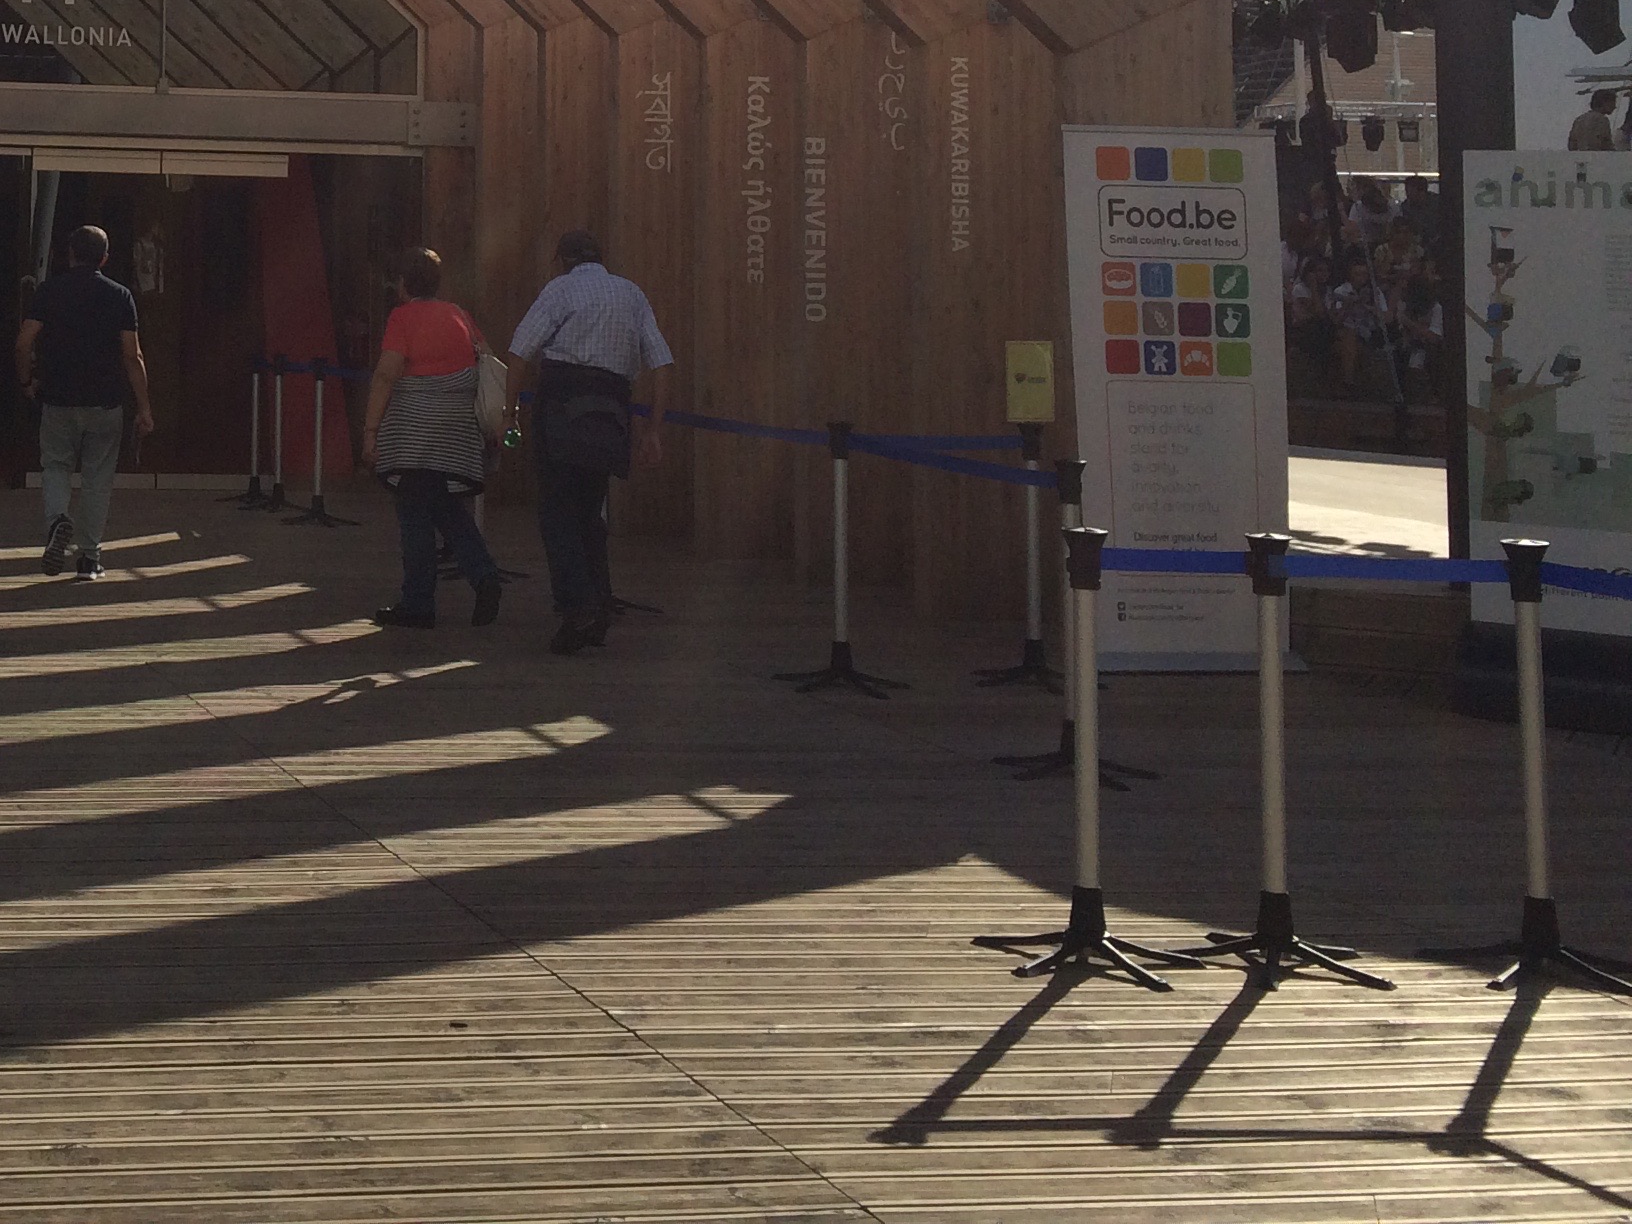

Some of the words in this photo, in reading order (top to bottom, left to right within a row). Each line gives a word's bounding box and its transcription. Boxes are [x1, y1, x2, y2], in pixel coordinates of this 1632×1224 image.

[1, 23, 133, 48] WALLONIA
[949, 56, 970, 253] KUWAKARIBISHA
[803, 136, 828, 323] BIENVENIDO
[1107, 198, 1237, 230] Food.be
[1109, 234, 1138, 245] Small
[1182, 236, 1213, 247] Great
